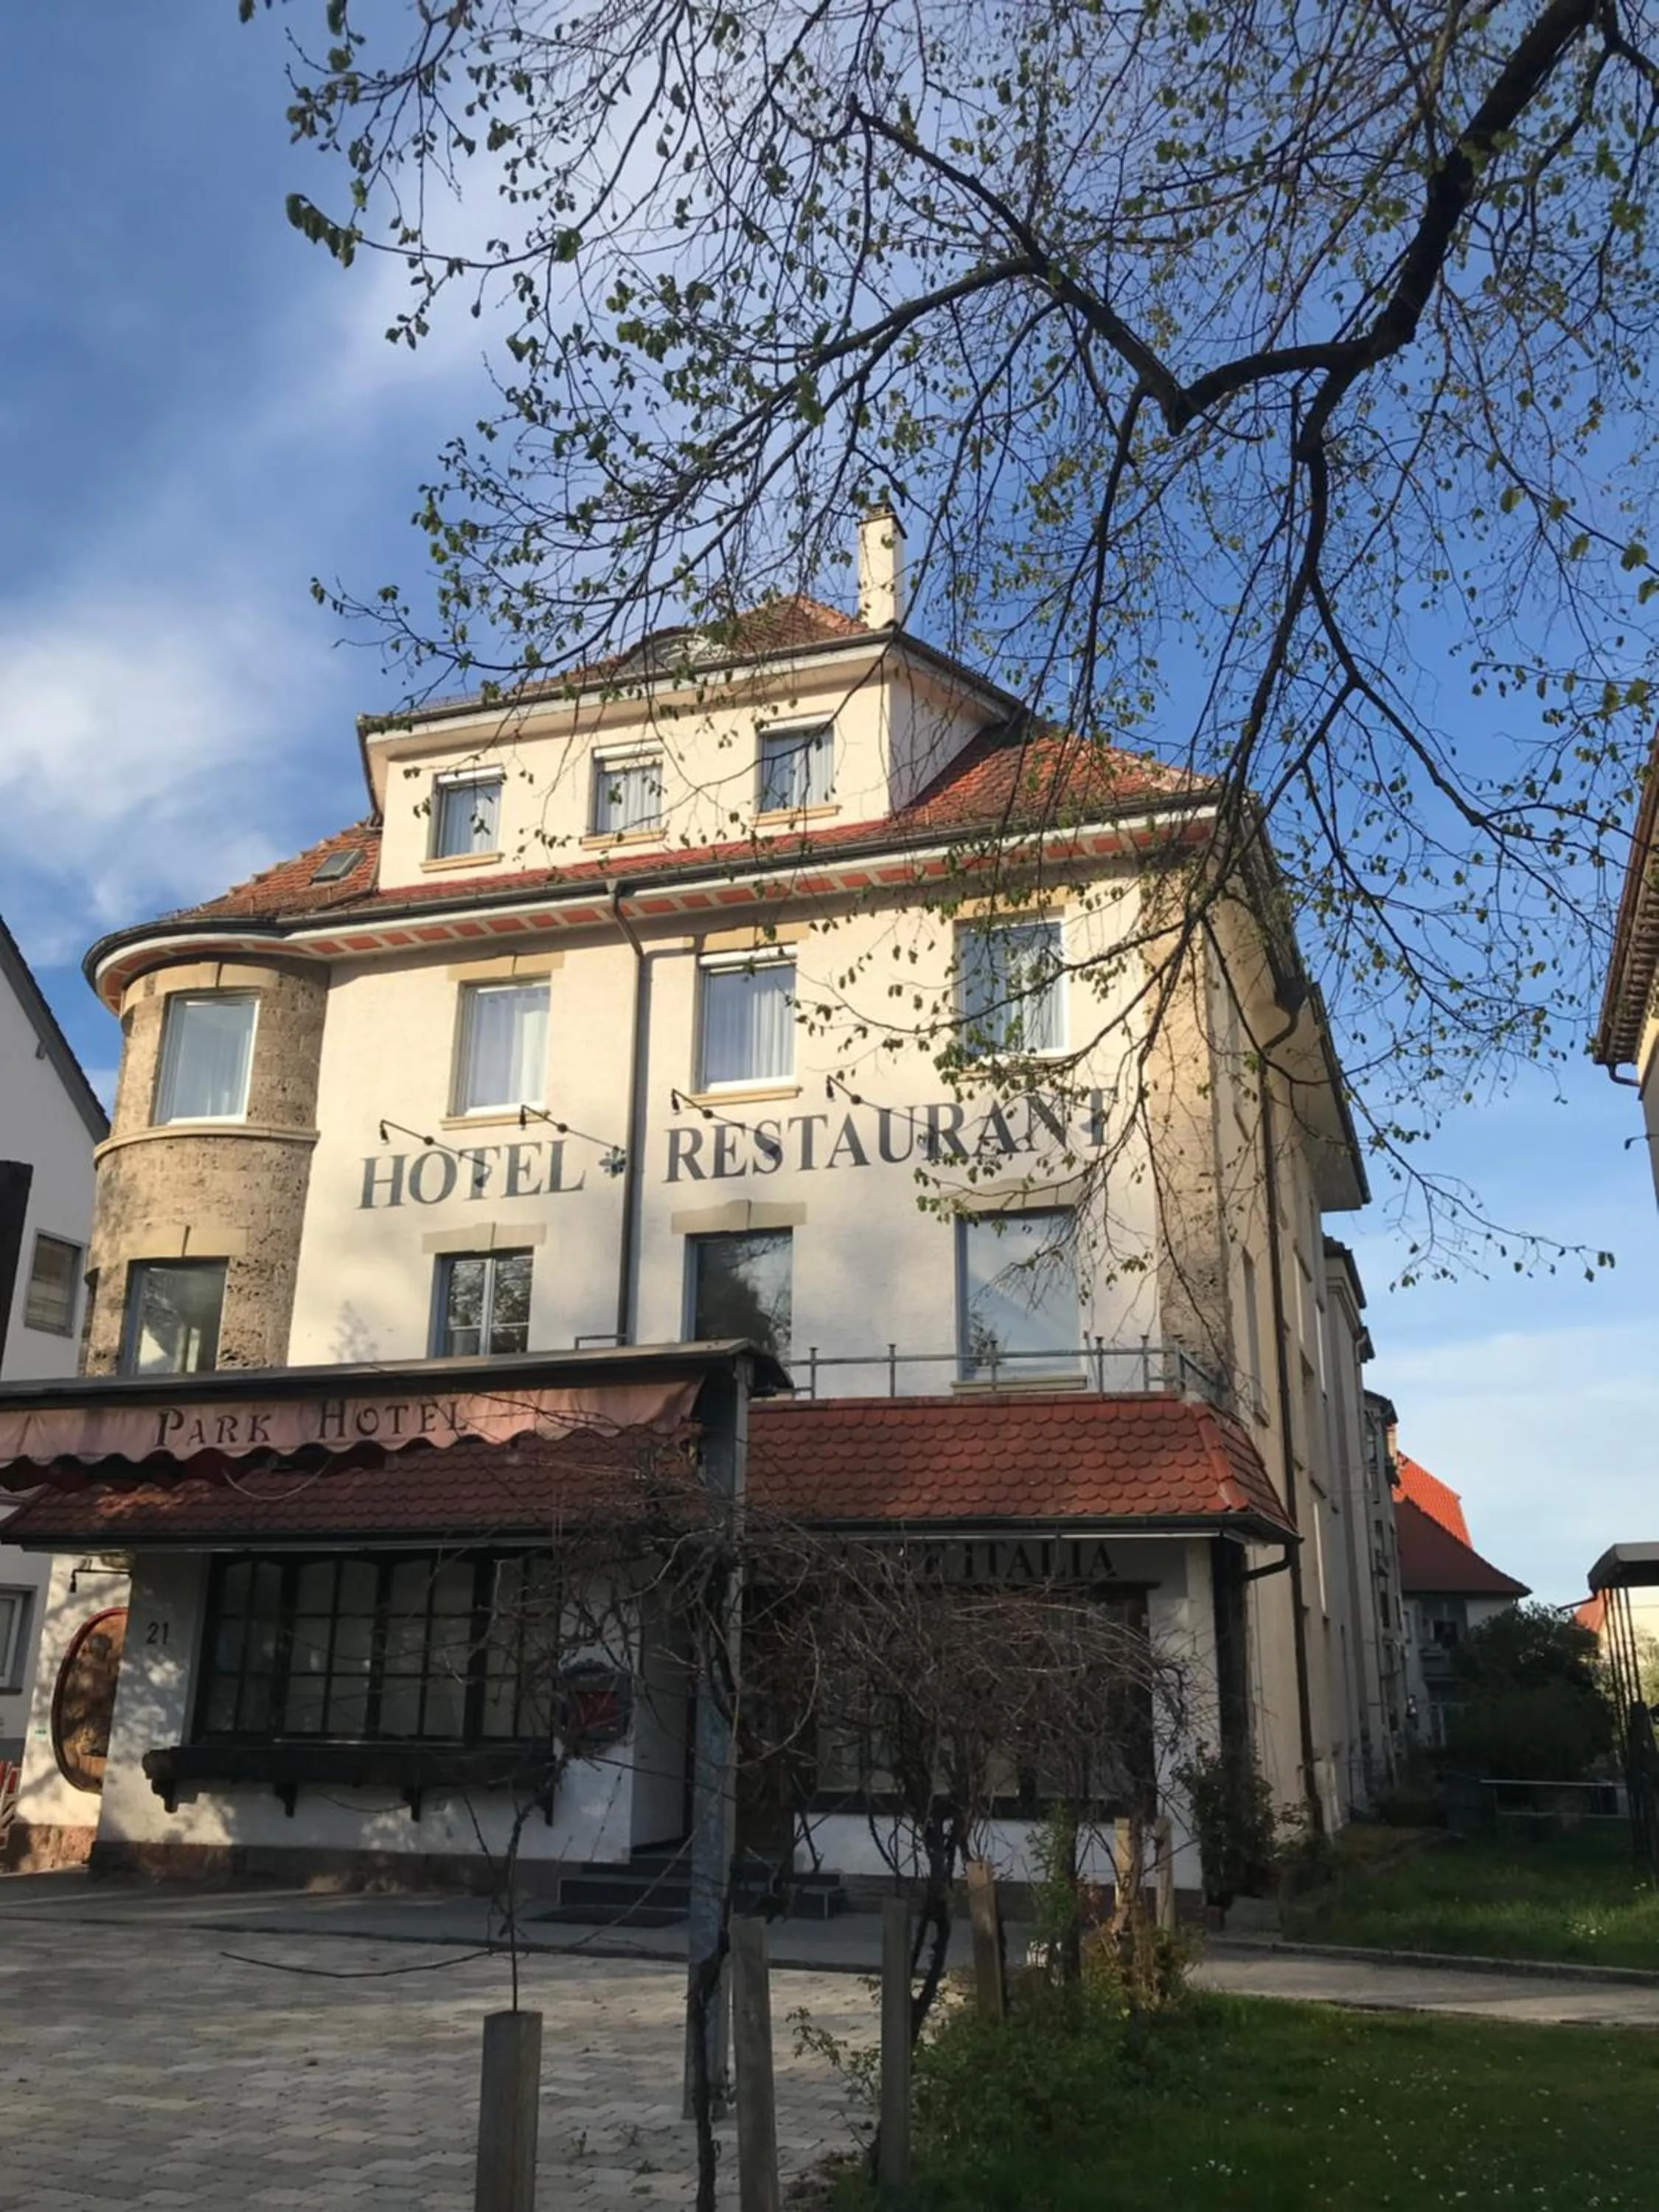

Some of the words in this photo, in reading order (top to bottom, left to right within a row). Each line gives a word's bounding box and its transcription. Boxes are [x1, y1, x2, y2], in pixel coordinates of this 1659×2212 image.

[356, 1140, 586, 1209] HOTEL
[661, 1089, 1116, 1183] RESTAURANT
[146, 1622, 169, 1644] 21
